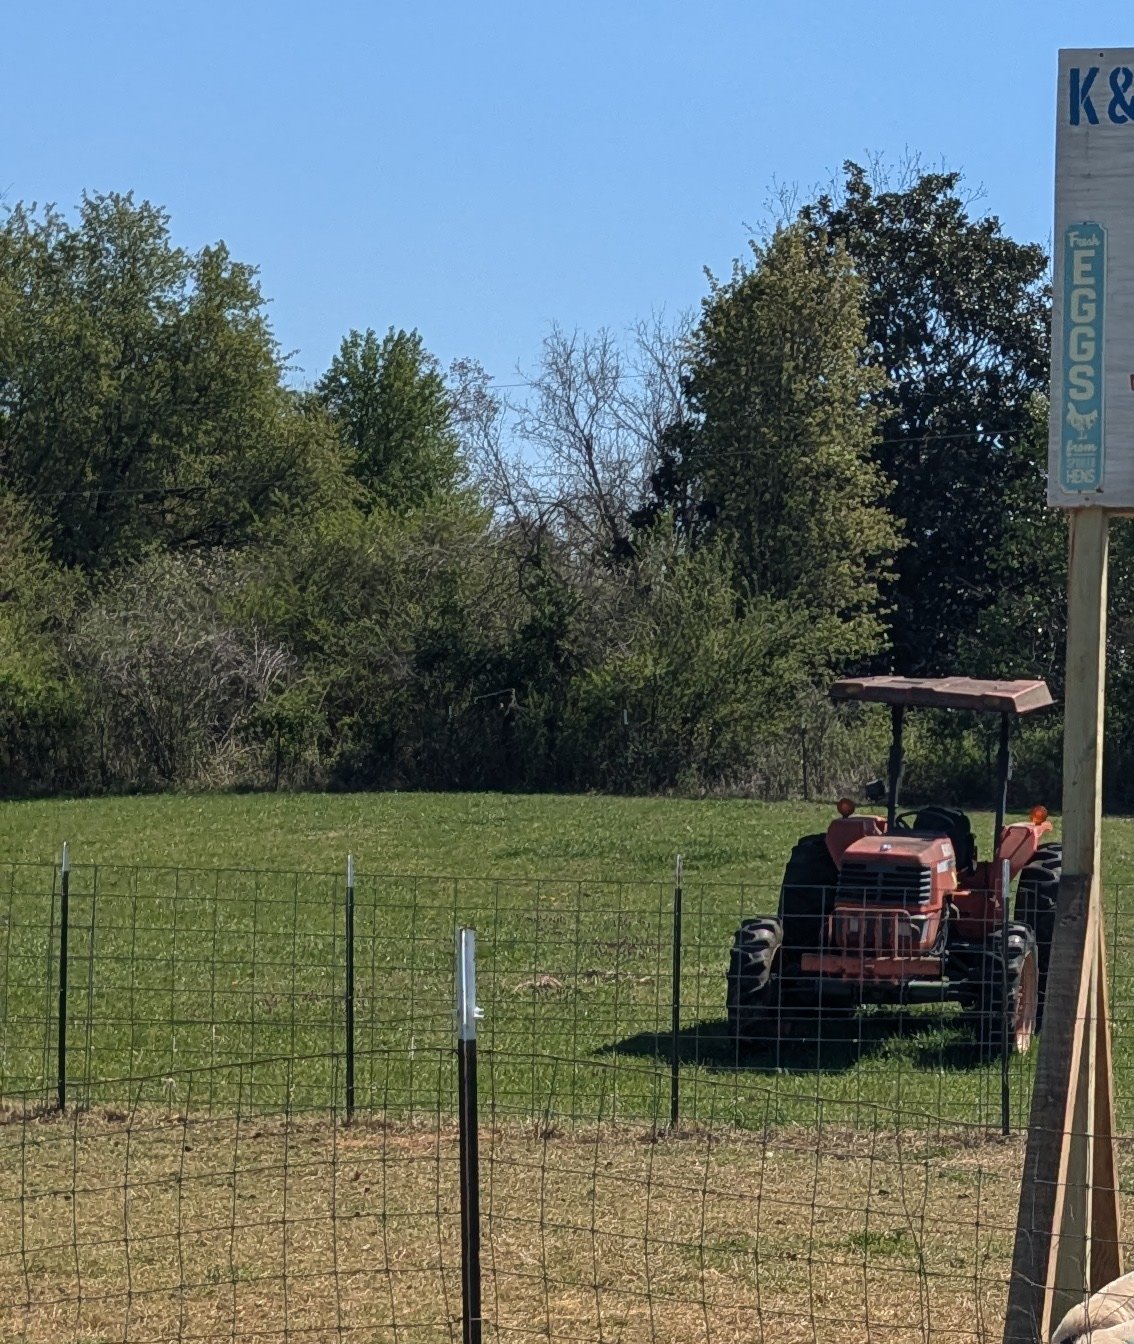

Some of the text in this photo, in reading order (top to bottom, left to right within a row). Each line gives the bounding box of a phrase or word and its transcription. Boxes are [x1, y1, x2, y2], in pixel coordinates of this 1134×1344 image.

[1067, 231, 1100, 248] Fresh
[1069, 249, 1096, 400] EGGS
[1066, 469, 1095, 483] HENS
